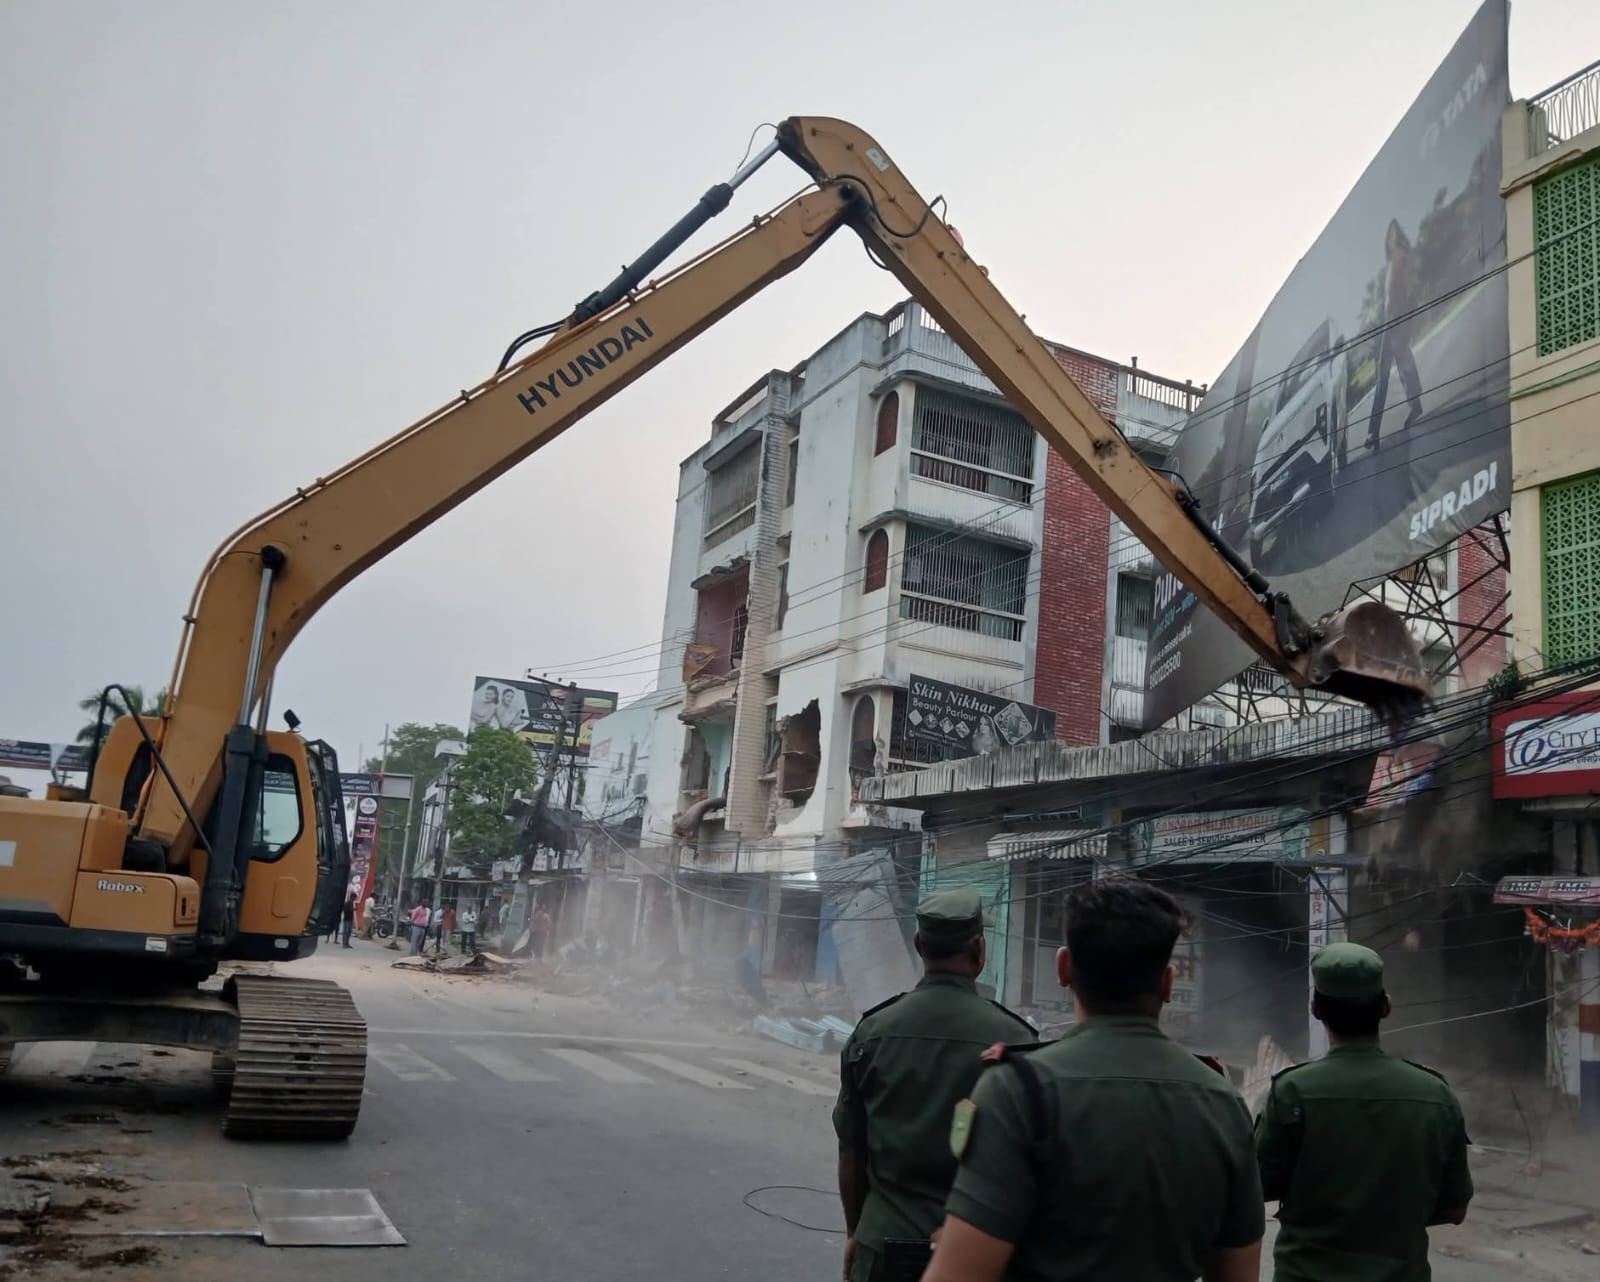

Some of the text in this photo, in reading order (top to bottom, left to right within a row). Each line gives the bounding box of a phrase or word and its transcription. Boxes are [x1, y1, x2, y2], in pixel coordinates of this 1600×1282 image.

[1441, 61, 1487, 129] TATA
[516, 317, 654, 415] HYUNDAI
[1408, 461, 1498, 541] SIPRADI
[911, 681, 996, 716] Skin Nikhar
[912, 697, 978, 722] Beauty Parlour
[1547, 730, 1588, 749] CITY
[1164, 835, 1188, 847] SALES
[1196, 834, 1231, 846] SERVICE
[97, 879, 145, 894] Robex
